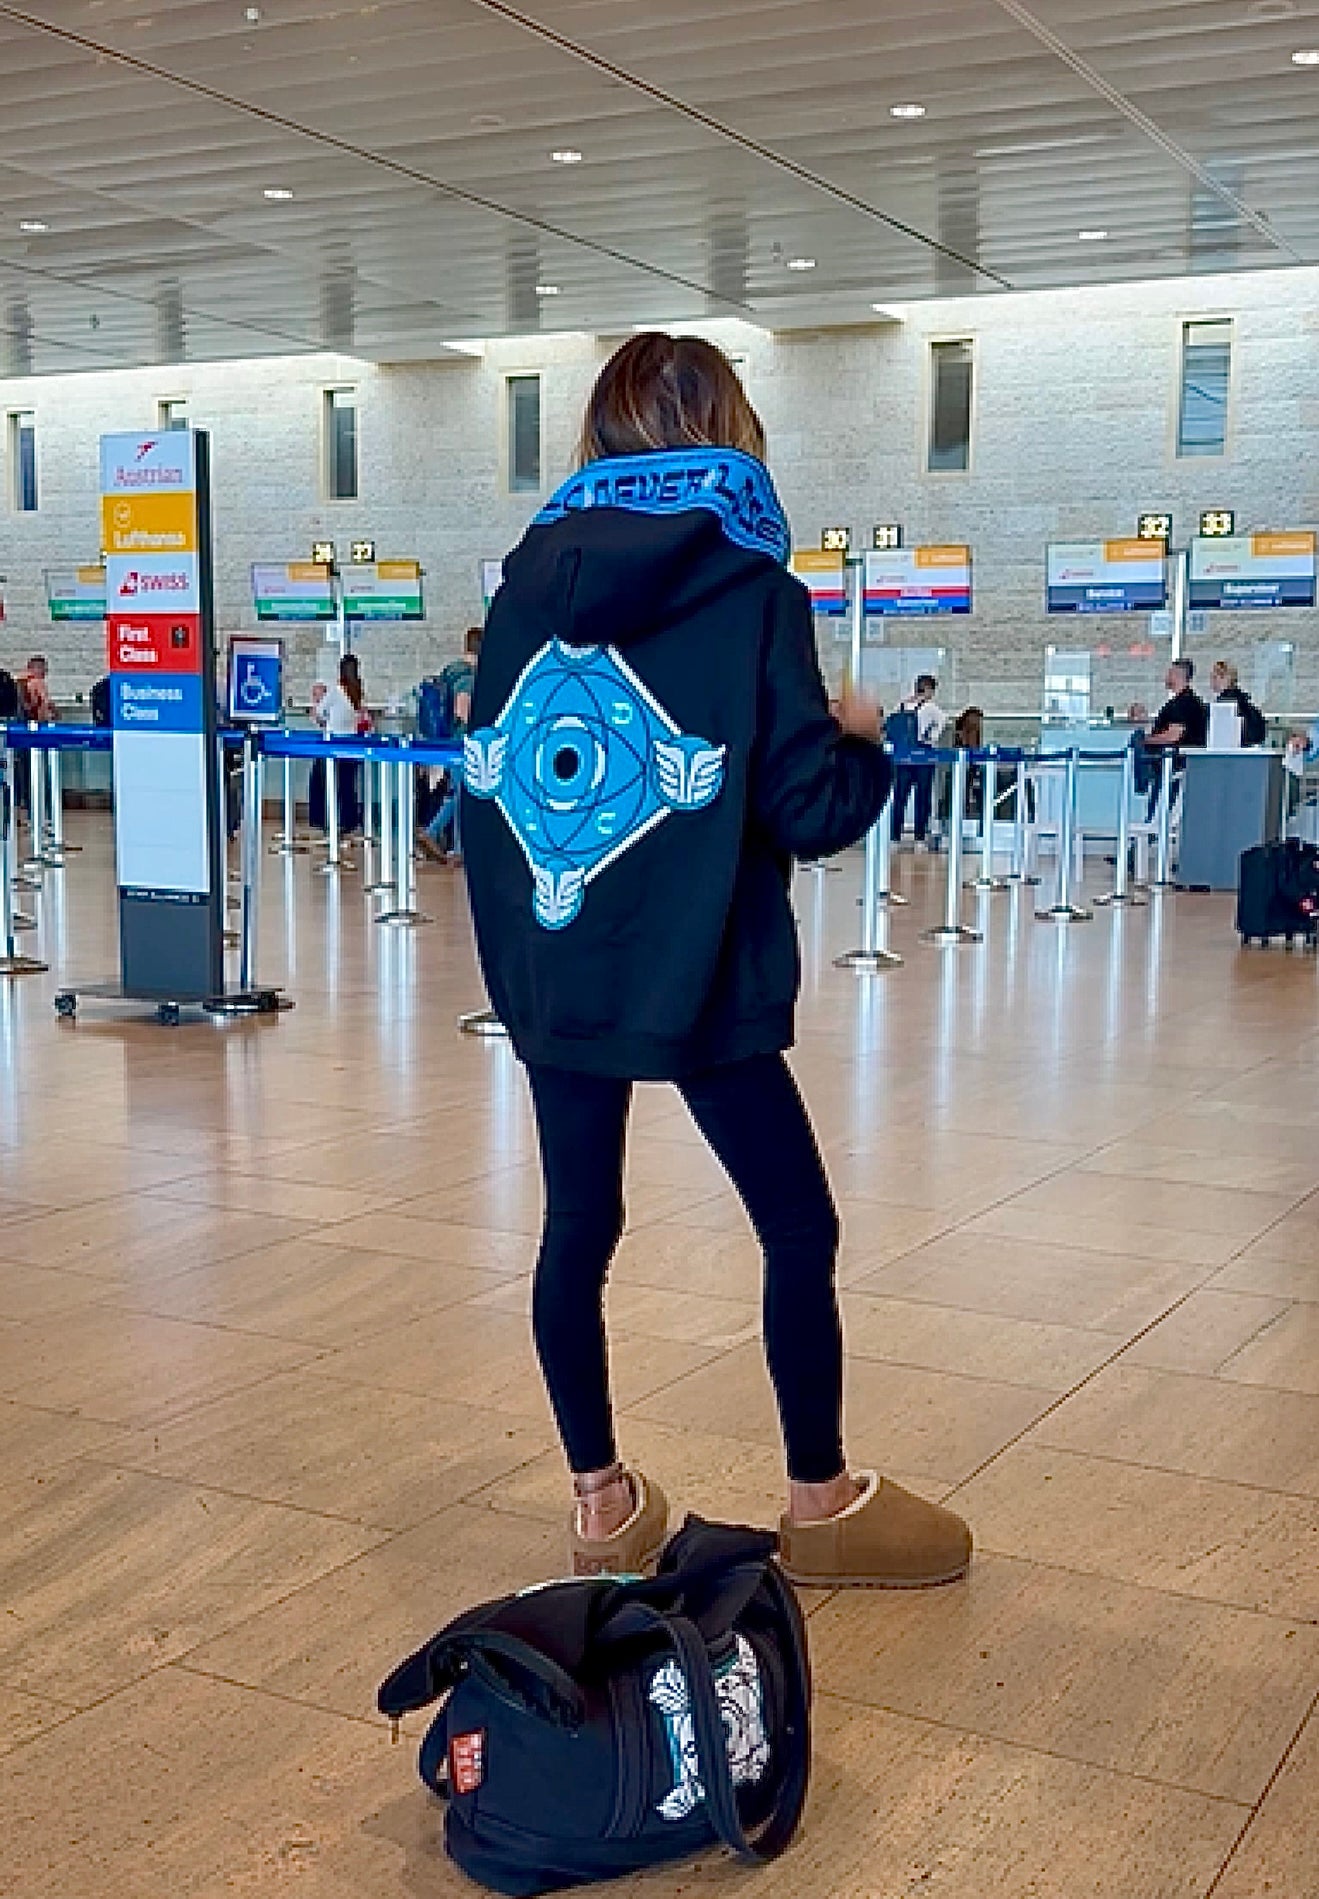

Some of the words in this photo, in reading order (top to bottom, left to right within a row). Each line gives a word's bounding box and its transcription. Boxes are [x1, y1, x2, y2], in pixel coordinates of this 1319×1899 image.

[118, 624, 150, 641] First
[118, 645, 159, 662] Class
[120, 682, 183, 701] Business
[120, 703, 159, 721] Class
